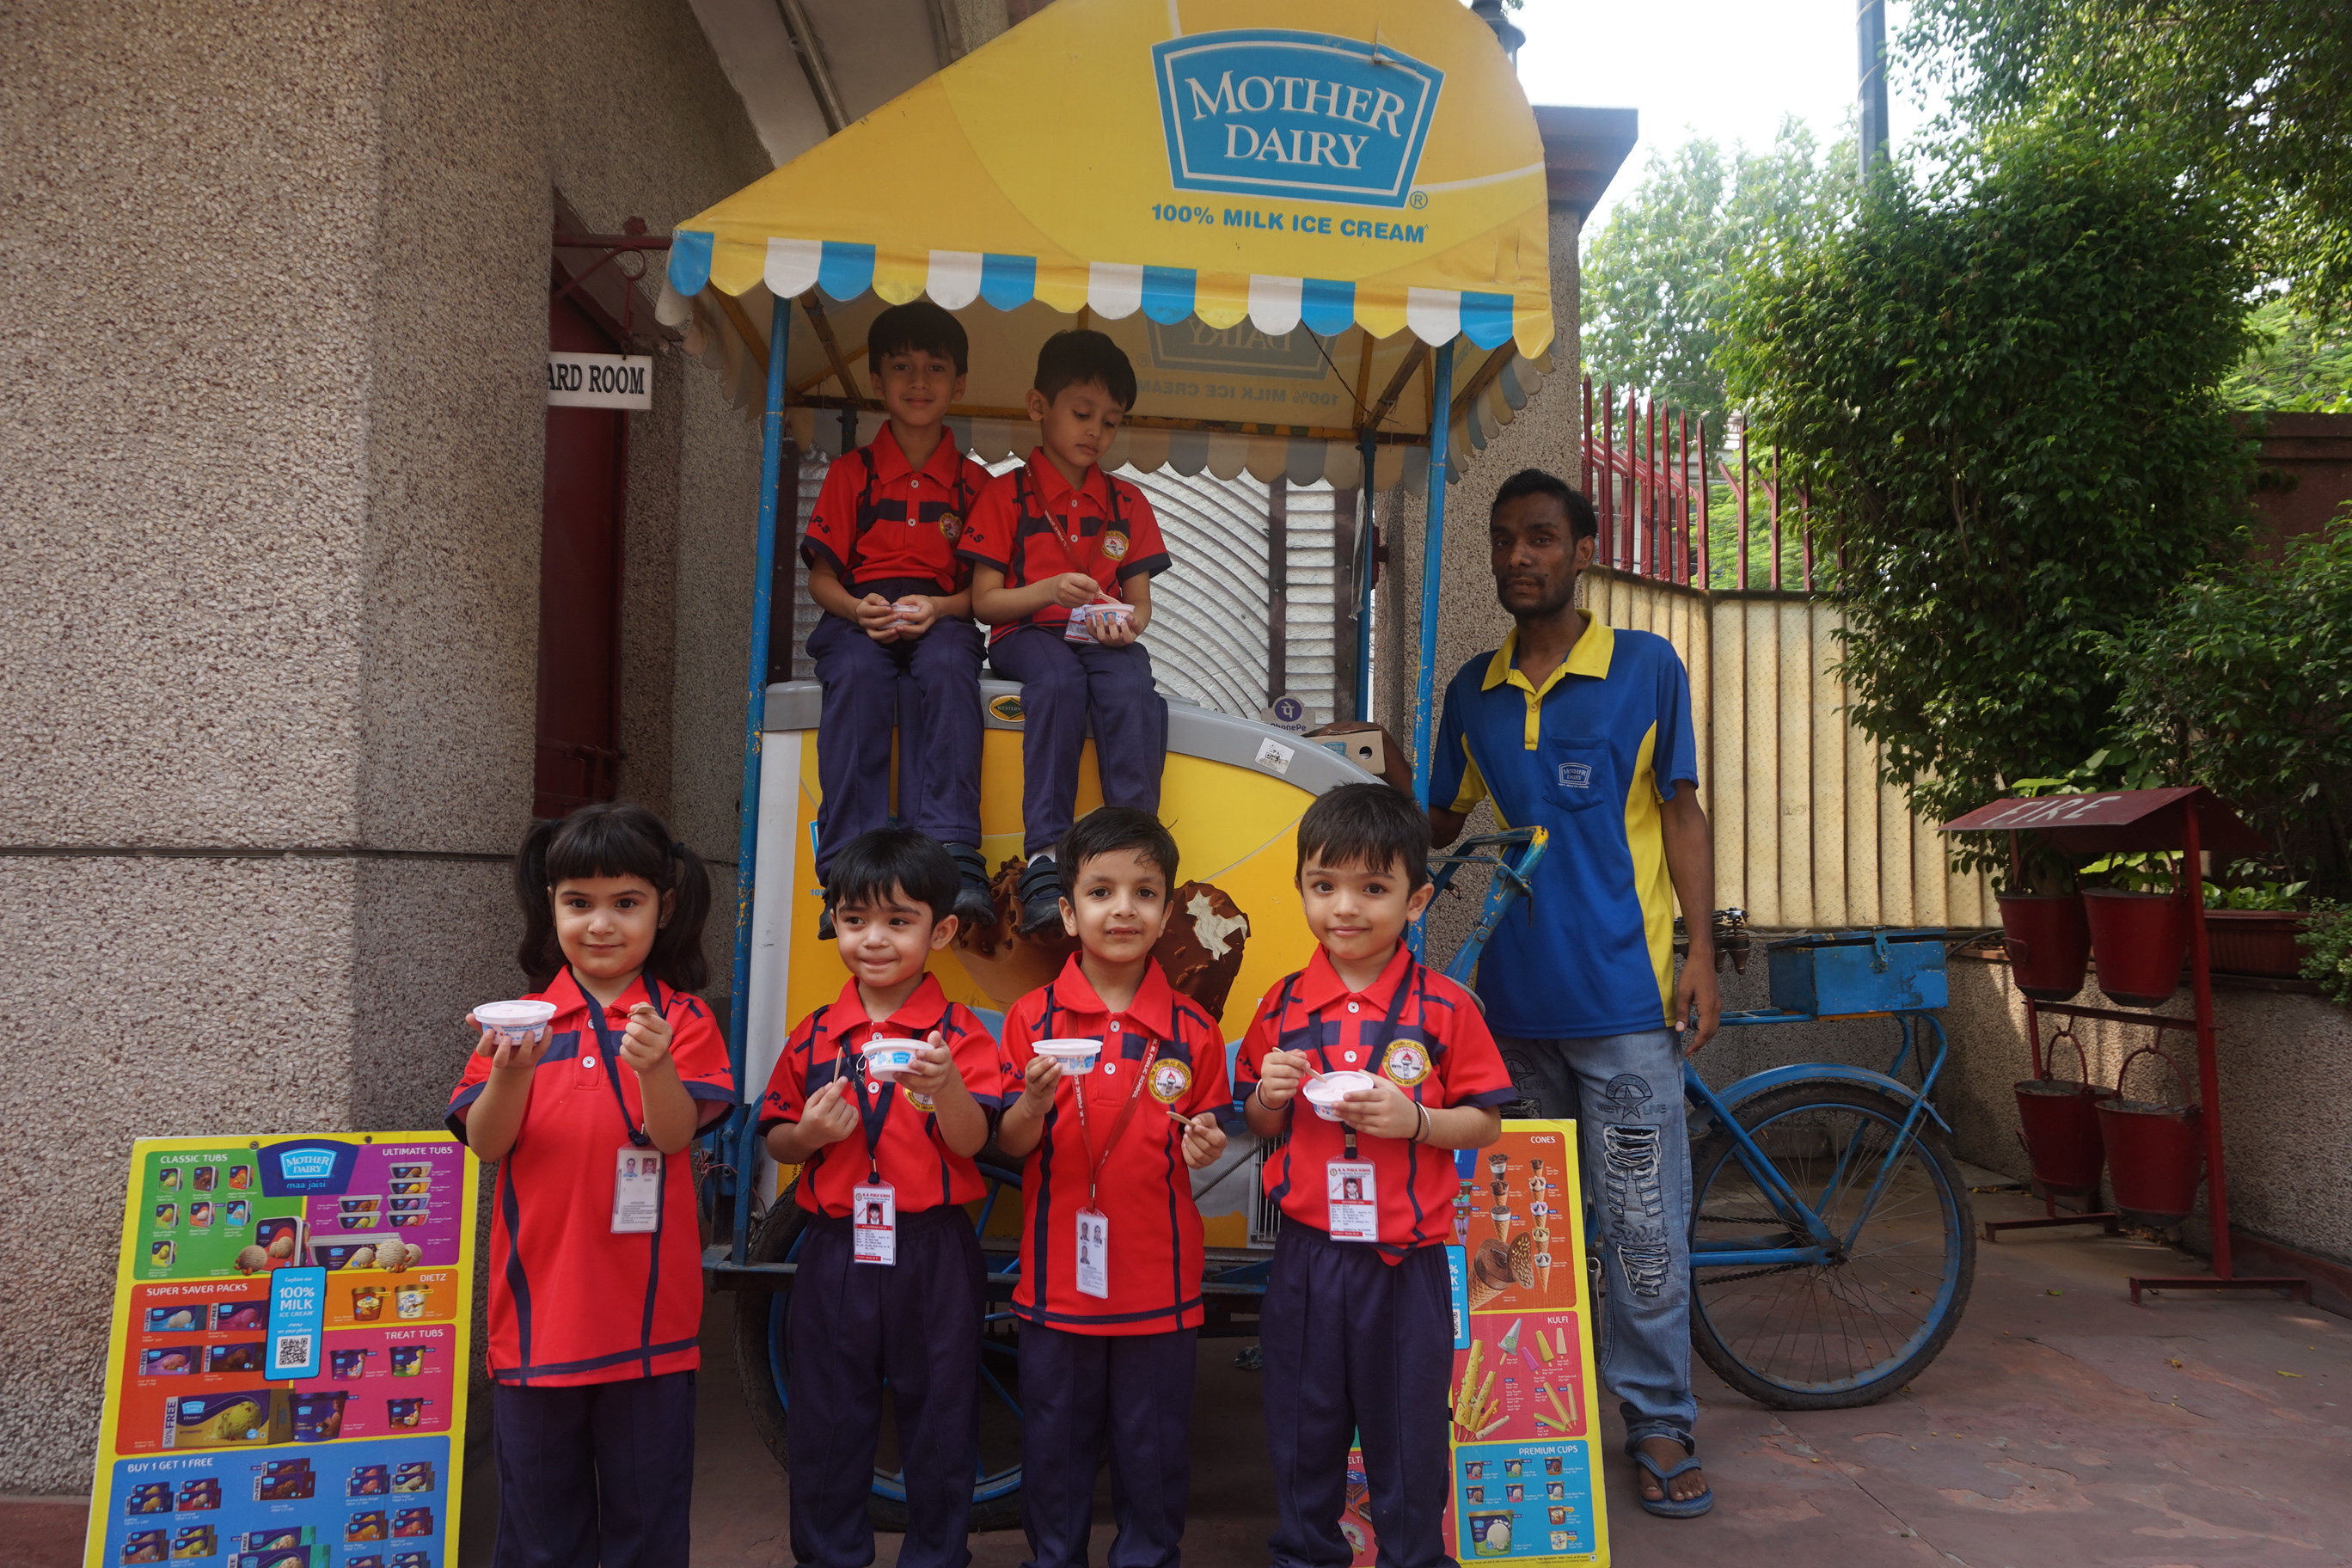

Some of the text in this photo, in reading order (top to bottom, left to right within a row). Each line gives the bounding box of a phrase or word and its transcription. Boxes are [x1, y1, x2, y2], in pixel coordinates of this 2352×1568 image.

[1185, 70, 1406, 137] MOTHER
[1224, 123, 1369, 170] DAIRY
[1152, 204, 1215, 225] 100%
[1224, 209, 1283, 230] MILK
[1292, 215, 1332, 235] ICE
[589, 364, 645, 394] ROOM
[1981, 795, 2122, 825] FIRE
[1413, 1044, 1428, 1062] SCHOOL
[1144, 1053, 1153, 1075] PUBLIC
[1177, 1063, 1190, 1081] SCHOOL
[1132, 1075, 1145, 1099] SCHOOL
[1530, 1136, 1556, 1144] CONES
[383, 1146, 453, 1155] ULTIMATE TUBS
[160, 1154, 228, 1164] CLASSIC TUBS
[285, 1155, 330, 1167] MOTHER
[293, 1165, 322, 1173] DAIRY
[306, 1179, 326, 1191] jaisi
[420, 1273, 447, 1282] DIETZ
[146, 1283, 248, 1296] SUPER SAVER PACKS
[279, 1287, 315, 1299] 100%
[280, 1299, 313, 1311] MILK
[385, 1329, 444, 1339] TREAT TUBS
[165, 1401, 176, 1430] FREE
[1519, 1445, 1578, 1455] PREMIUM CUPS
[127, 1458, 213, 1473] BUY 1 GET 1 FREE
